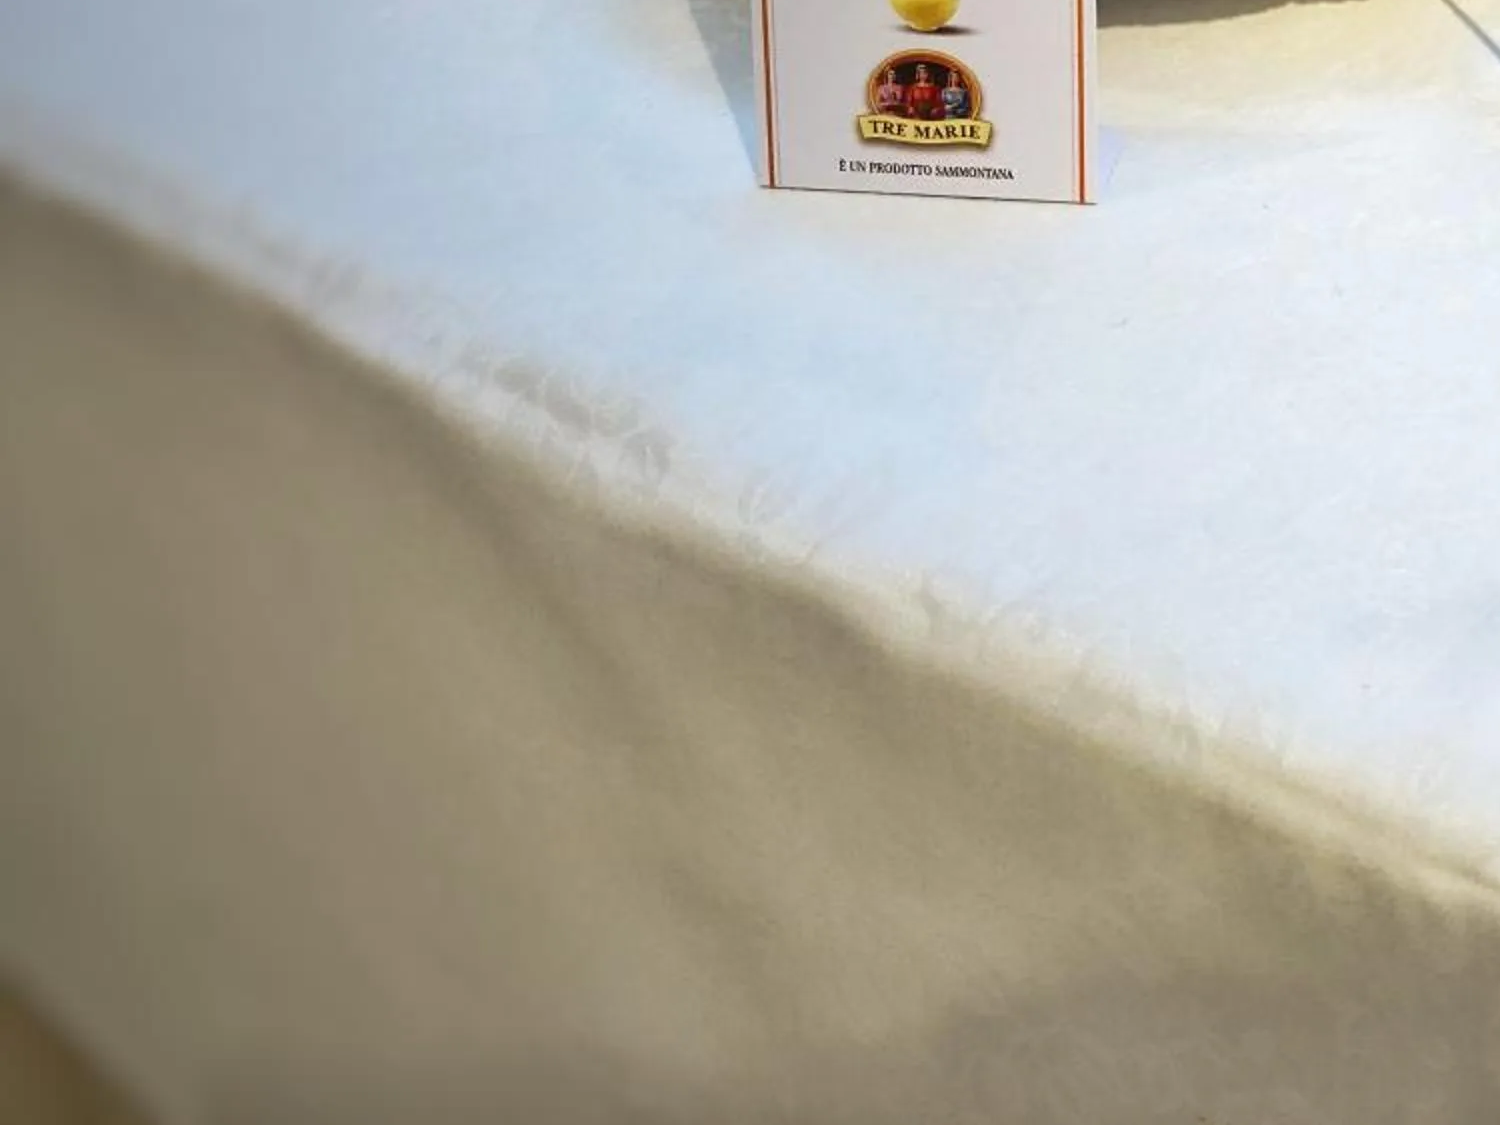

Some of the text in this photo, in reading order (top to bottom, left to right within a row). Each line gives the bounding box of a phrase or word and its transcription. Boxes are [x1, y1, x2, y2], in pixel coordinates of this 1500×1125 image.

[868, 119, 981, 140] TRE MARIE
[850, 161, 866, 172] UN
[869, 161, 932, 176] PRODOTTO
[935, 164, 1014, 180] SAMMONTANA
